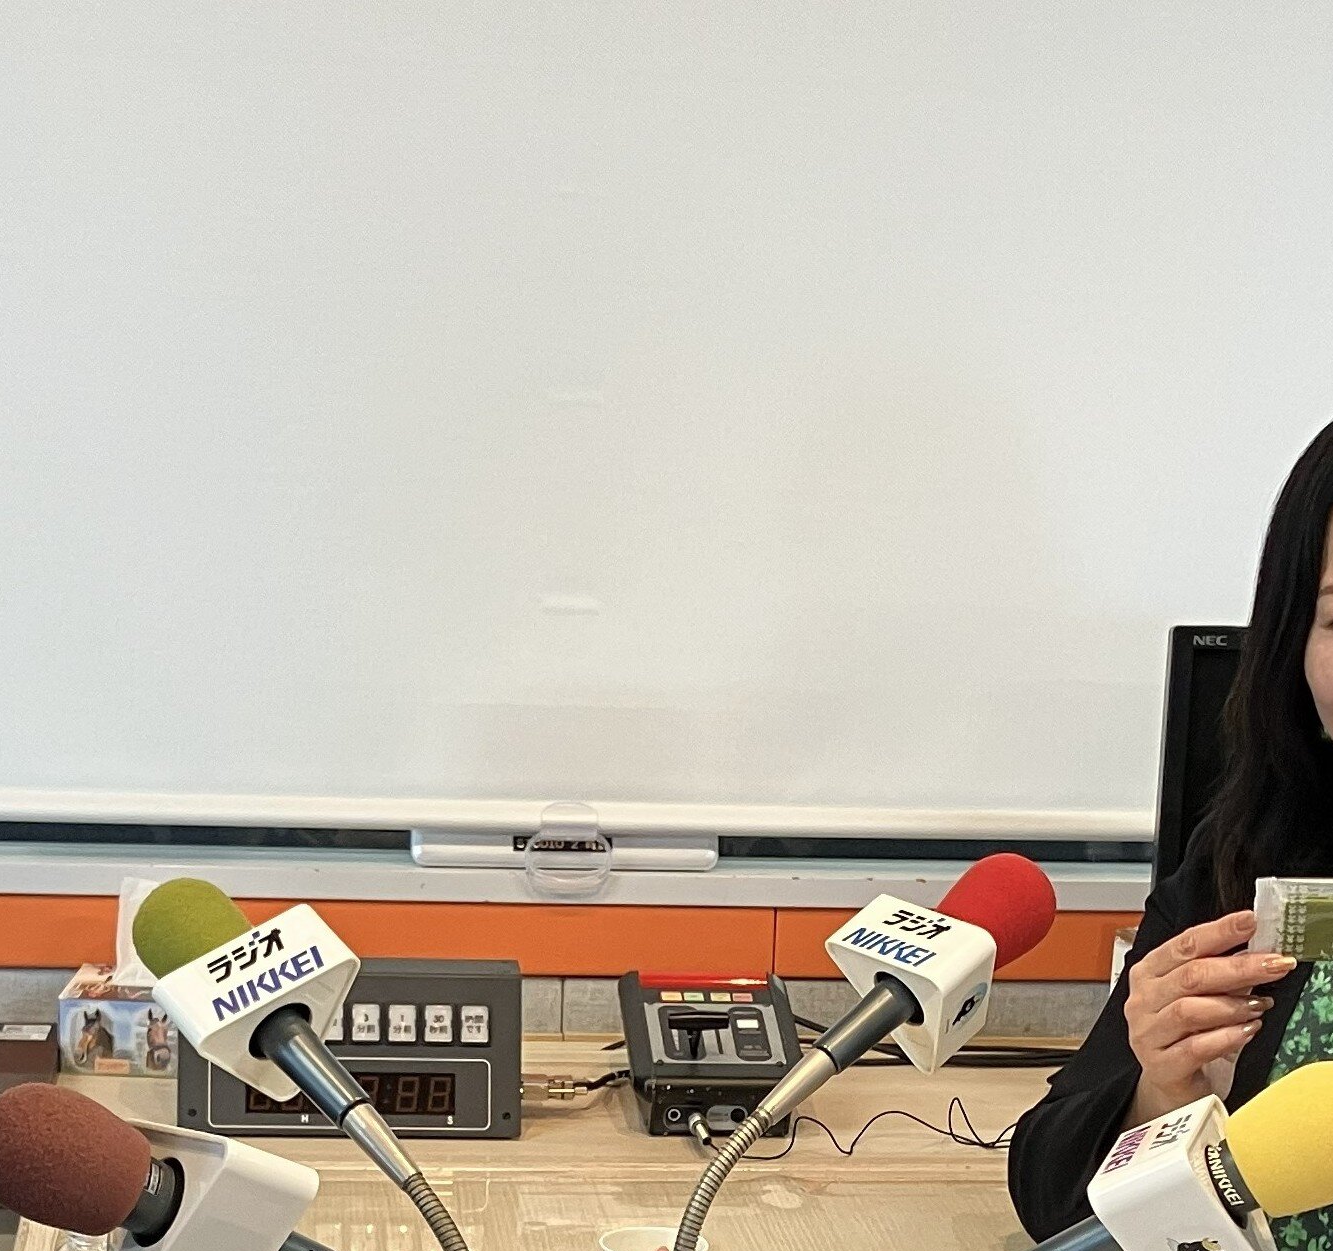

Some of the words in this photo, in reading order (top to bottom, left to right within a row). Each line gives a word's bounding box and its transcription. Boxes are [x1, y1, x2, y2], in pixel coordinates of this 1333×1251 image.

[1193, 635, 1228, 646] NEC
[882, 910, 951, 939] ラジオ
[207, 928, 285, 983] ラジオ
[842, 928, 936, 967] NIKKEI
[212, 946, 324, 1021] NIKKEI
[433, 1014, 445, 1023] 30
[301, 1115, 309, 1123] H
[447, 1115, 454, 1125] S
[1149, 1114, 1193, 1150] ラジオ
